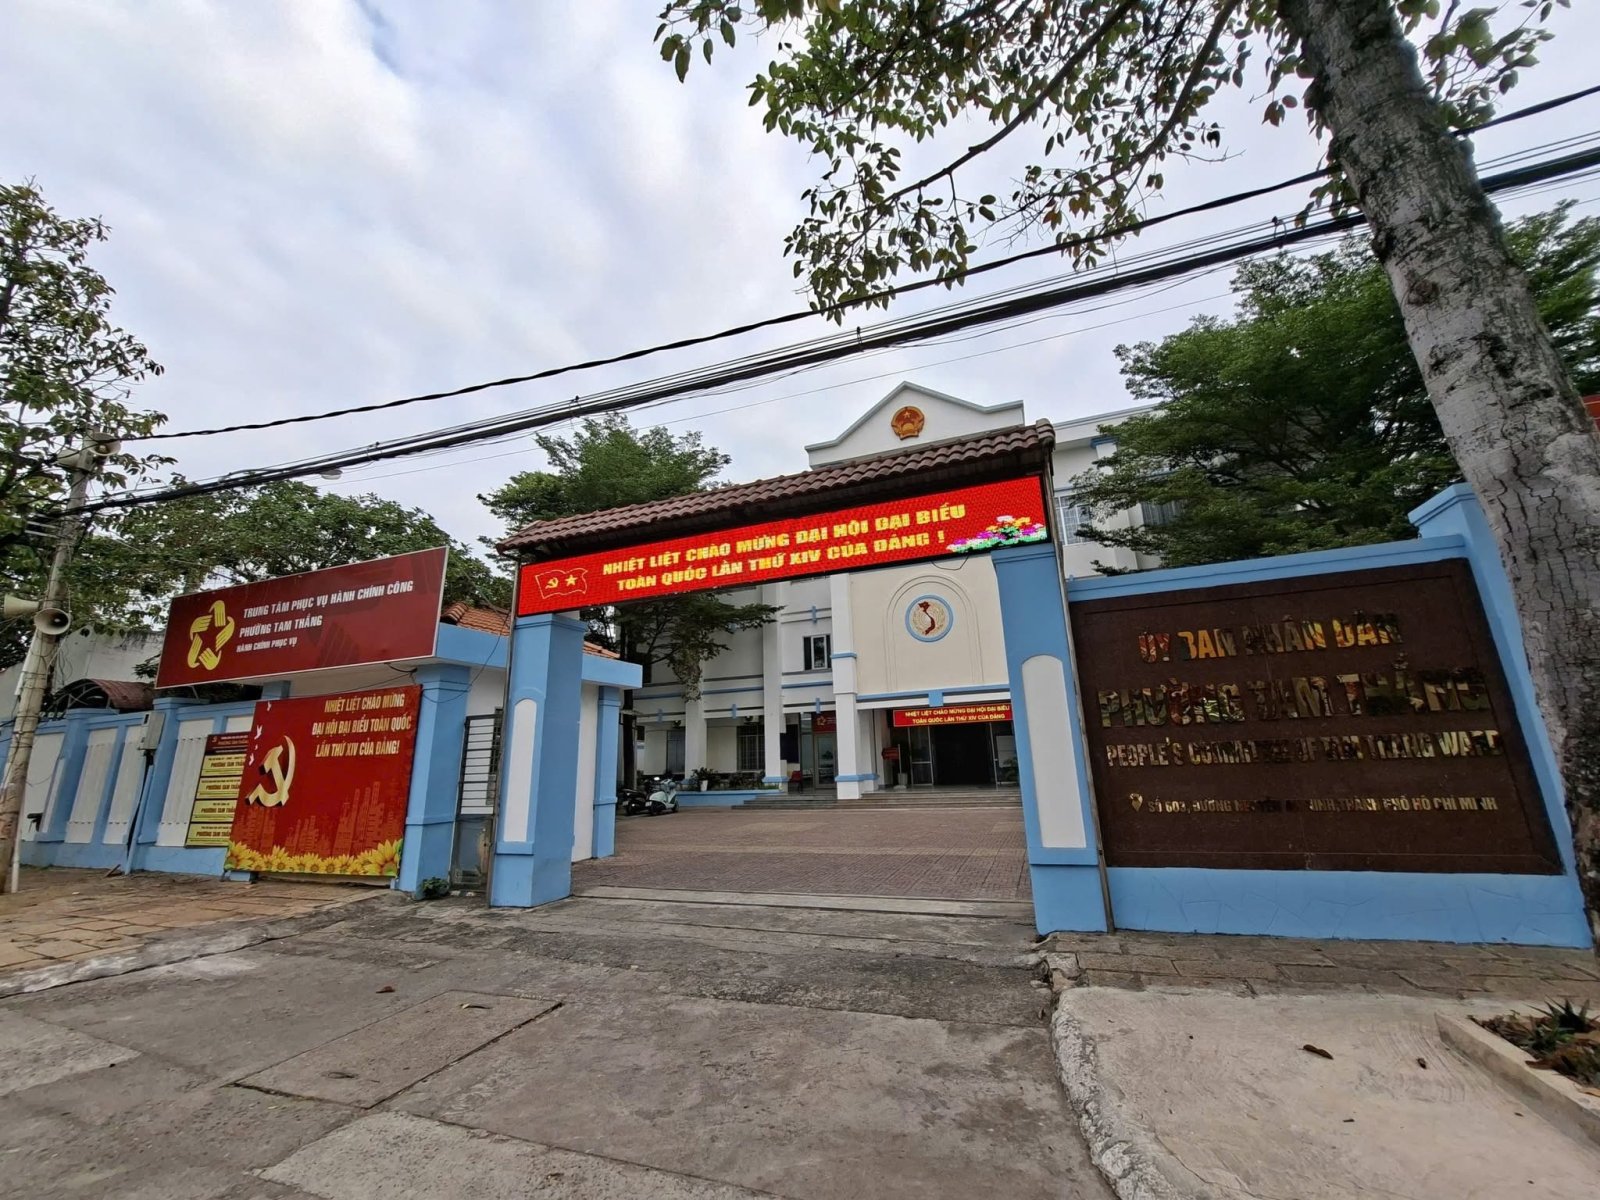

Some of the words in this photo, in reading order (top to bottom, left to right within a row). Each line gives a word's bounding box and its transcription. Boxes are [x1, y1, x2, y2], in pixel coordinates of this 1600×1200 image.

[603, 557, 645, 575] NHIỆT
[650, 552, 681, 570] LIỆT
[686, 543, 731, 562] CHÀO
[736, 533, 790, 554] MỪNG
[796, 527, 828, 544] ĐẠI
[833, 520, 869, 538] HỘI
[875, 513, 910, 531] ĐẠI
[916, 502, 966, 525] BIỂU
[617, 575, 657, 591] TOÀN
[661, 566, 707, 586] QUỐC
[712, 559, 743, 577] LẦN
[749, 552, 786, 571] THỨ
[790, 550, 821, 565] XIV
[827, 541, 868, 560] CỦA
[874, 534, 930, 552] ĐẢNG
[244, 604, 269, 618] TRUNG
[271, 601, 290, 614] TÂM
[291, 597, 314, 612] PHỤC
[316, 595, 328, 608] VỤ
[330, 590, 354, 605] HÀNH
[357, 585, 384, 600] CHÍNH
[387, 580, 414, 595] CÔNG
[239, 622, 272, 638] PHƯỜNG
[274, 620, 292, 632] TAM
[294, 614, 322, 629] THẮNG
[1177, 626, 1237, 660] BAN
[1241, 614, 1327, 656] NHÂN
[1332, 610, 1403, 648] DÂN
[236, 642, 252, 653] HÀNH
[254, 640, 270, 650] CHÍNH
[271, 638, 288, 649] PHỤC
[288, 637, 297, 648] VỤ
[325, 697, 345, 714] NHIỆT
[346, 696, 361, 713] LIỆT
[362, 694, 381, 710] CHÀO
[382, 692, 405, 708] MỪNG
[949, 706, 966, 714] MỪNG
[1098, 677, 1246, 728] PHƯỜNG
[1247, 676, 1333, 720] TAM
[312, 722, 325, 738] ĐẠI
[325, 719, 338, 737] HỘI
[338, 720, 351, 736] ĐẠI
[352, 714, 370, 733] BIỂU
[370, 716, 390, 732] TOÀN
[391, 712, 412, 732] QUỐC
[316, 740, 331, 757] LẦN
[331, 740, 345, 757] THỨ
[345, 742, 359, 756] XIV
[359, 738, 373, 755] CỦA
[376, 737, 400, 754] ĐẢNG!
[1106, 737, 1184, 766] PEOPLE'S
[1298, 736, 1318, 762] OF
[1438, 730, 1502, 756] WARD
[1412, 795, 1431, 810] HỒ
[1434, 795, 1457, 810] CHÍ
[1460, 796, 1498, 810] MINH
